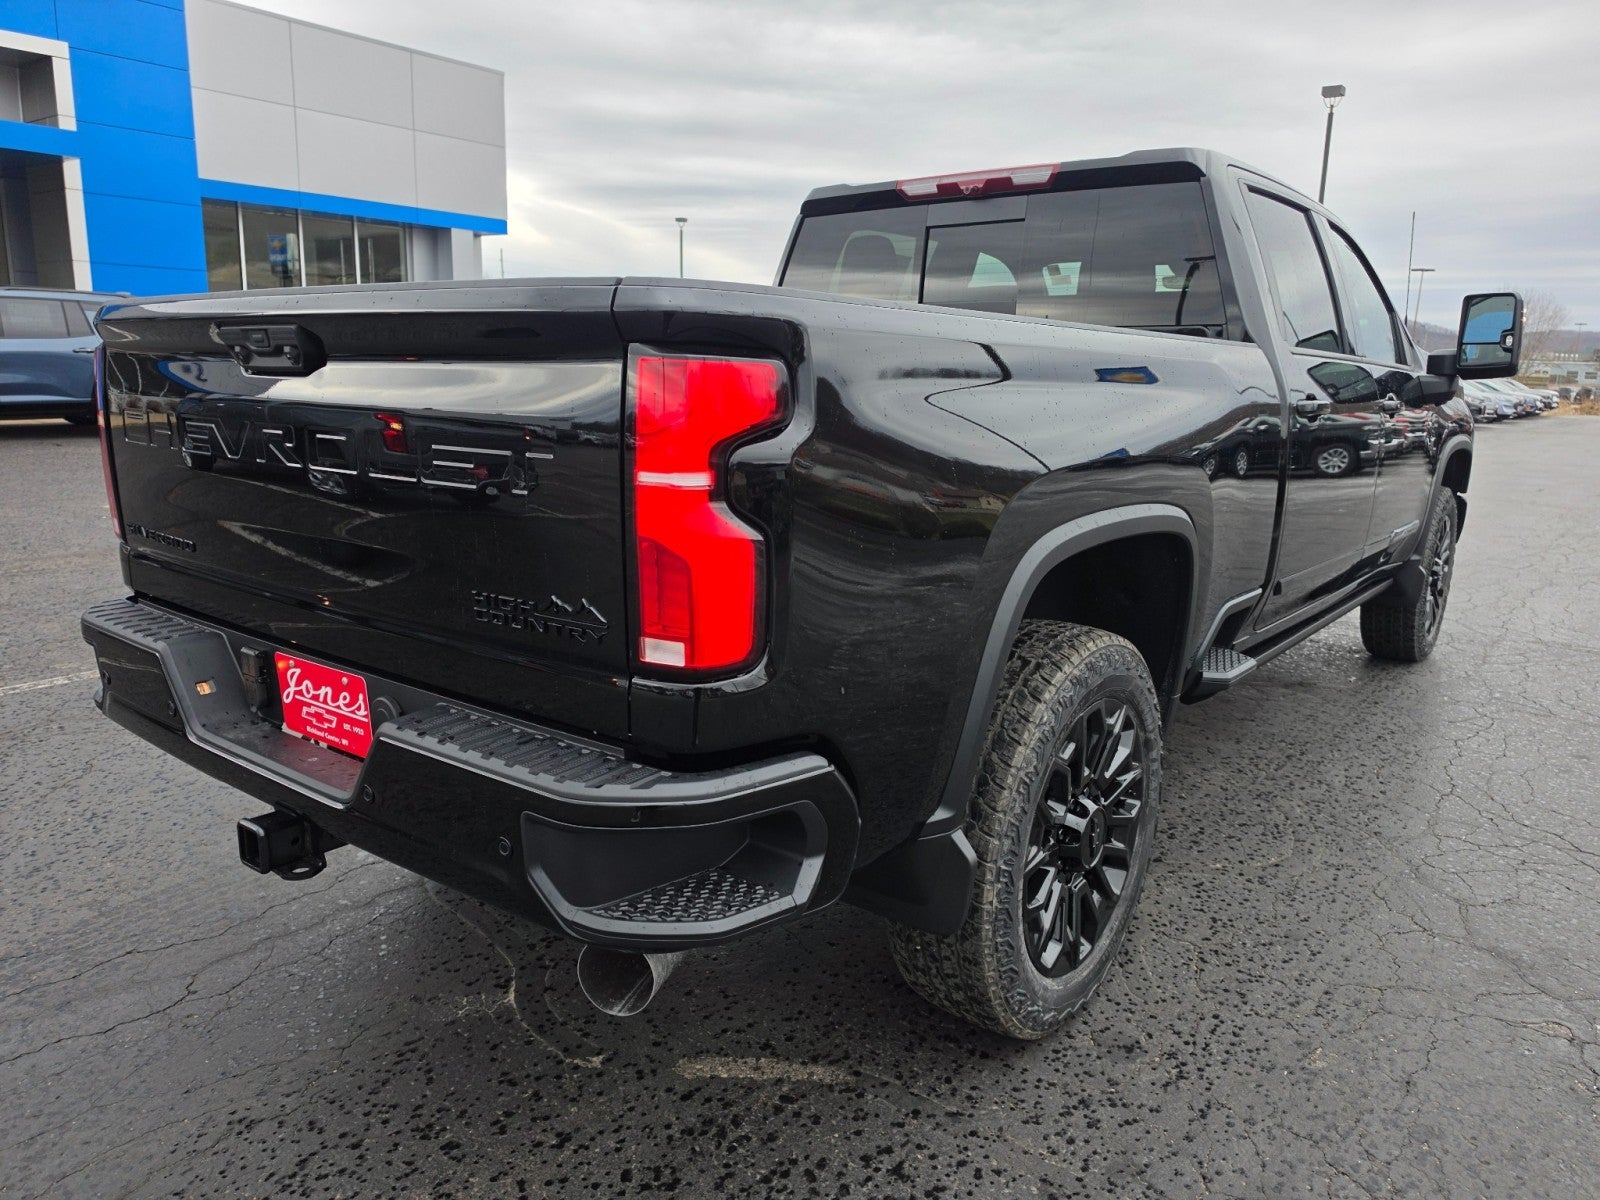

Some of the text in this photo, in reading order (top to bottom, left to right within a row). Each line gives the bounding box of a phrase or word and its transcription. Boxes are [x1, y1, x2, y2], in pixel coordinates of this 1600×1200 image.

[123, 408, 554, 496] CHEVROLET
[126, 522, 197, 552] SILVERADO
[471, 589, 535, 615] HIGH
[472, 607, 609, 645] COUNTRY
[283, 668, 368, 716] Jones
